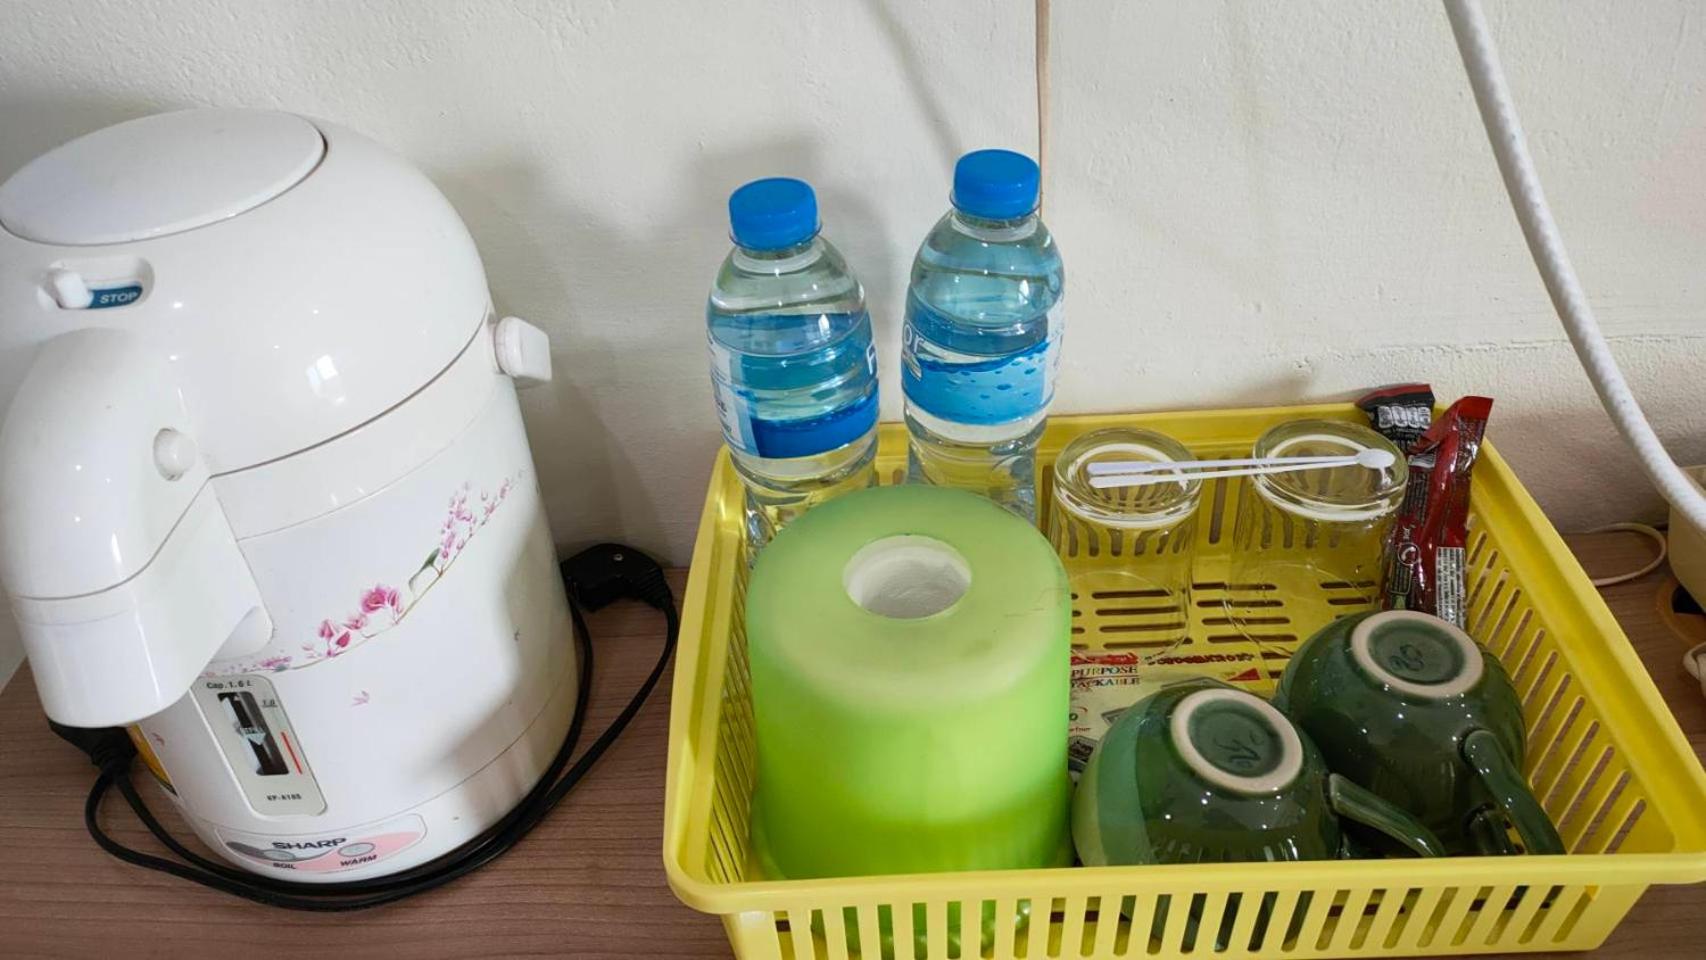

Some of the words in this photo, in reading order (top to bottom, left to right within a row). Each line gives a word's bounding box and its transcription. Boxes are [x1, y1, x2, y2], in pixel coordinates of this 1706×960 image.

[100, 291, 138, 304] STOP
[1071, 666, 1138, 677] PURPOSE
[1071, 677, 1140, 688] TACKABLE
[271, 837, 347, 850] SHARP
[272, 862, 297, 870] BOIL
[340, 854, 377, 867] WARM
